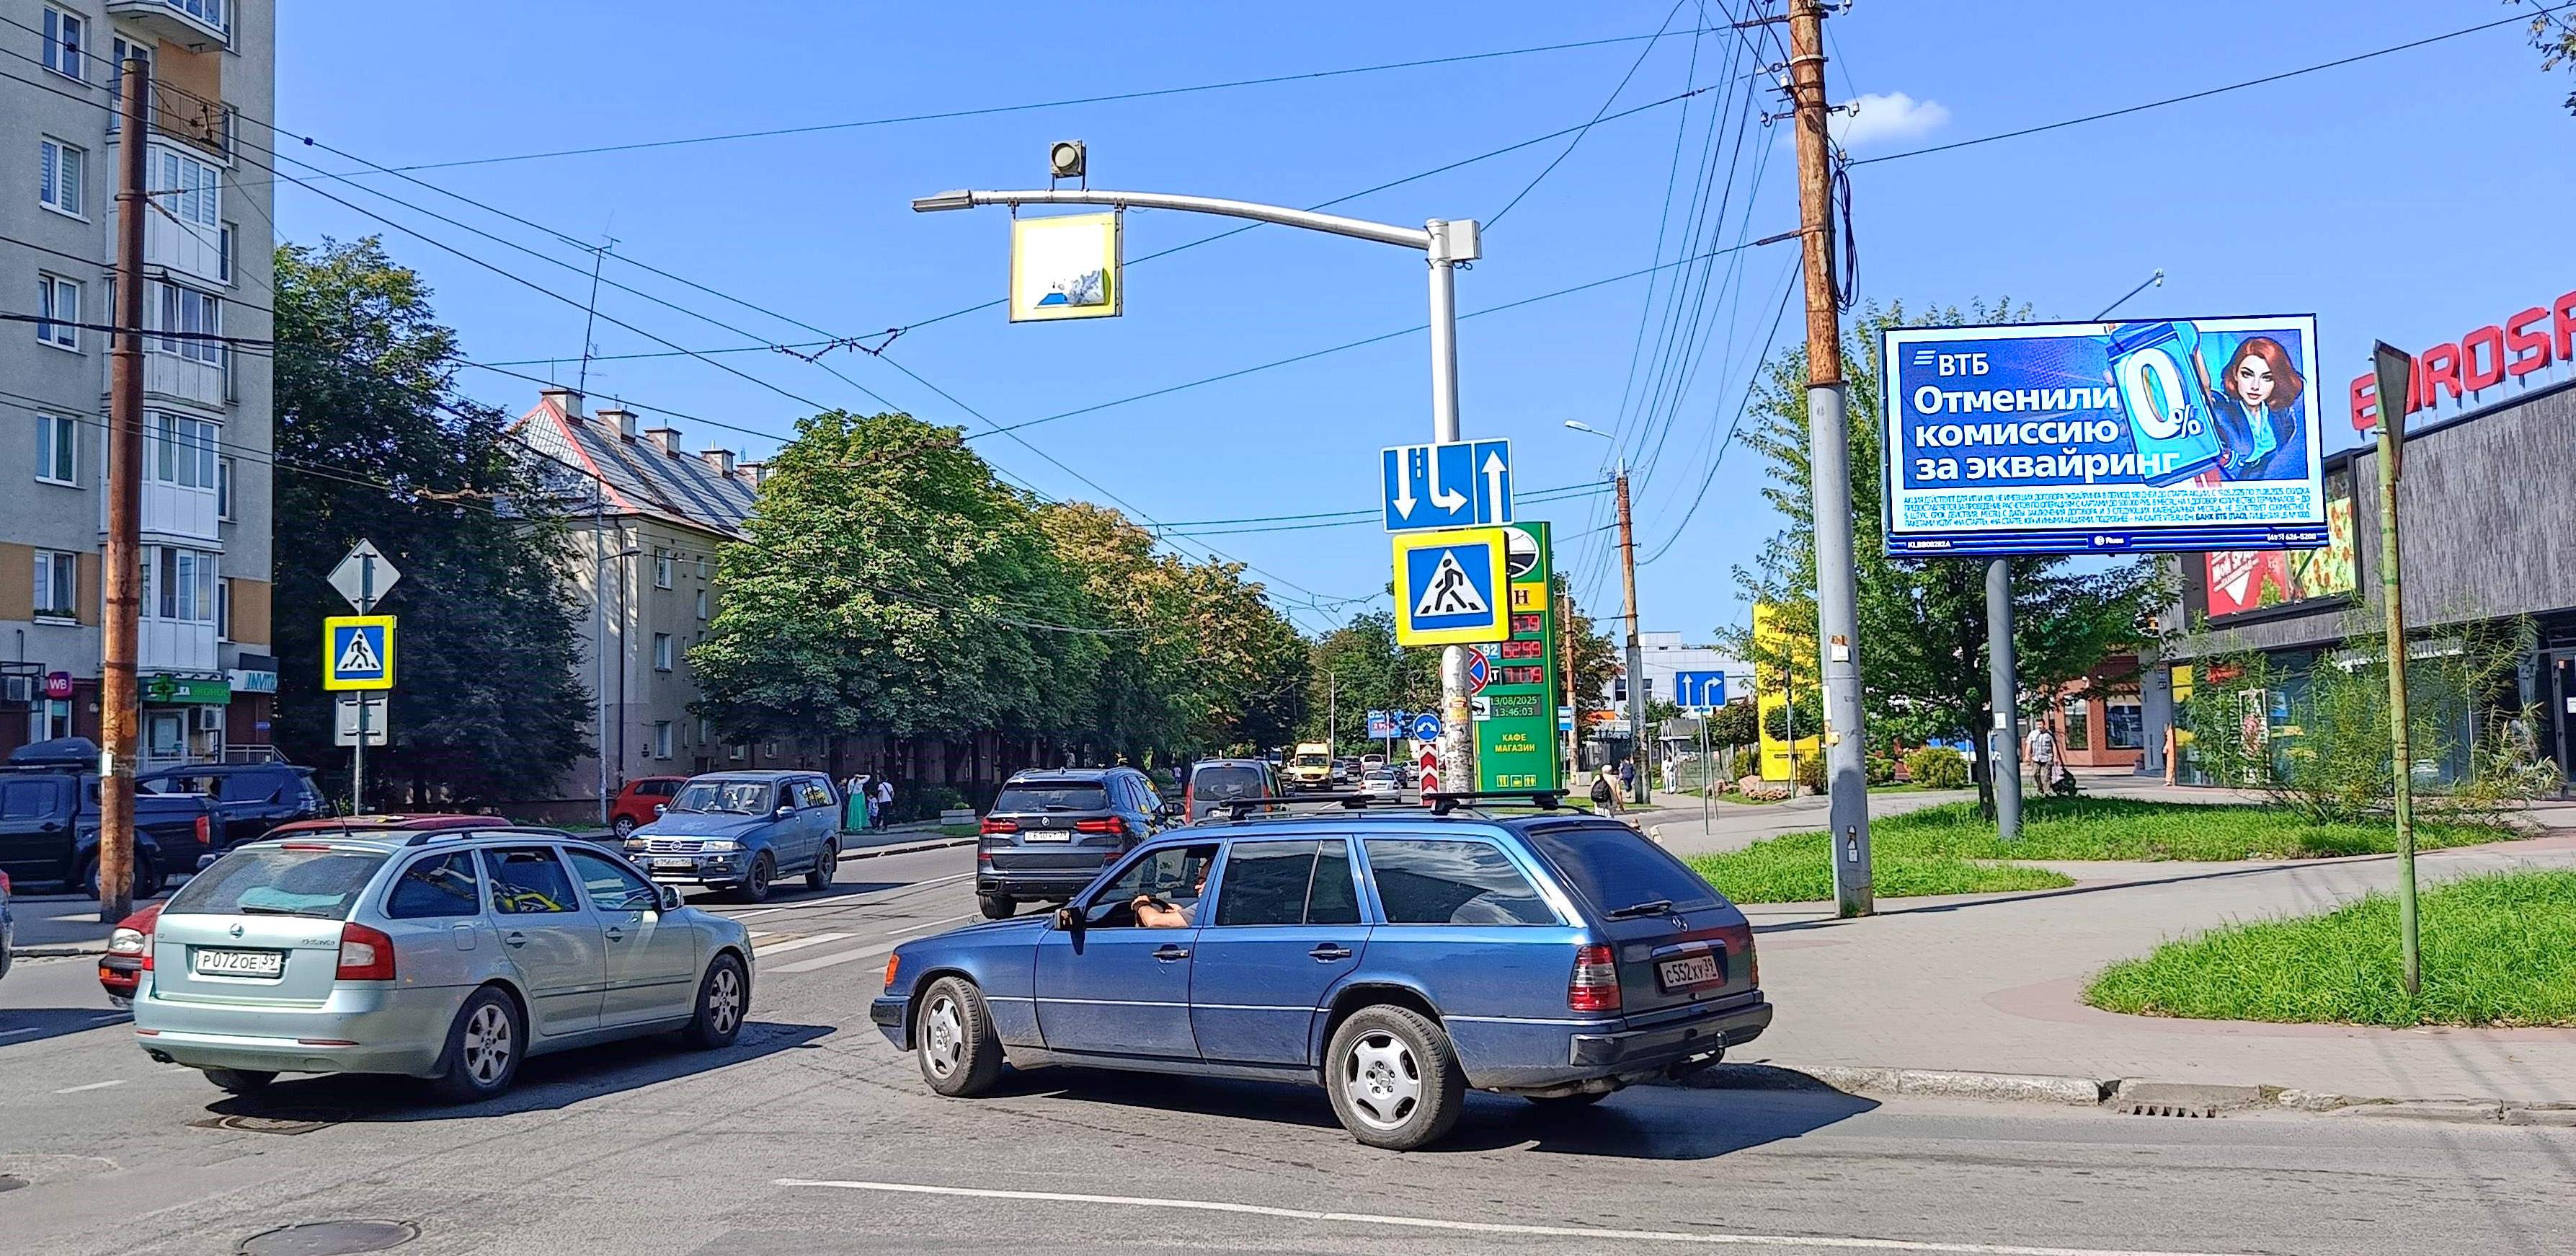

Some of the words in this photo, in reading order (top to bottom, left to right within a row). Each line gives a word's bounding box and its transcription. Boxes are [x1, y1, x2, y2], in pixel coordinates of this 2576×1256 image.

[1939, 353, 1989, 376] ВТБ
[1914, 385, 2118, 415] Отменили
[1915, 420, 2119, 447] комиссию
[1916, 457, 1959, 480] за
[1966, 447, 2180, 483] эквайринг
[1483, 644, 1498, 656] 92
[49, 678, 68, 690] WB
[1495, 707, 1533, 717] 13:46:03
[1494, 743, 1535, 753] МАГАЗИН
[202, 952, 257, 970] Р072ОЕ
[261, 953, 276, 965] 39
[1666, 963, 1703, 983] С552ХУ
[1702, 958, 1713, 973] 39
